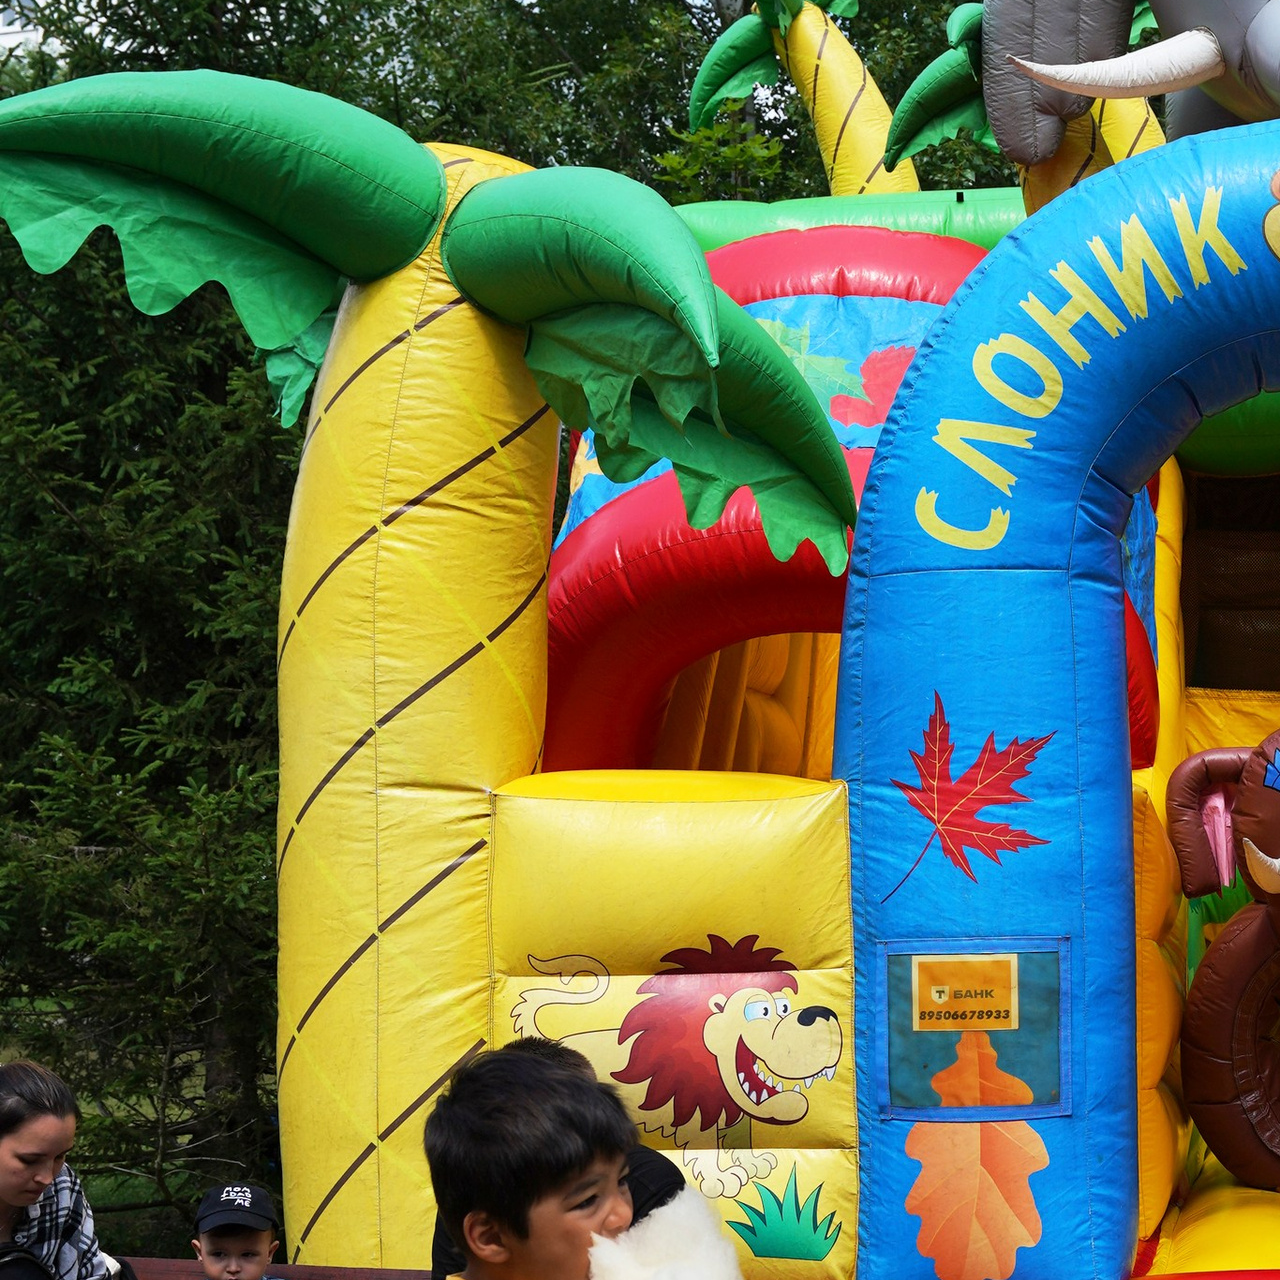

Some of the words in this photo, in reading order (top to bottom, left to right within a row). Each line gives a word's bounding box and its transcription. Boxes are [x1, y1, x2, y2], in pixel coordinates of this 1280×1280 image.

[914, 184, 1247, 552] СЛОНИК
[953, 989, 995, 999] БАНК
[918, 1009, 1011, 1021] 89506678933
